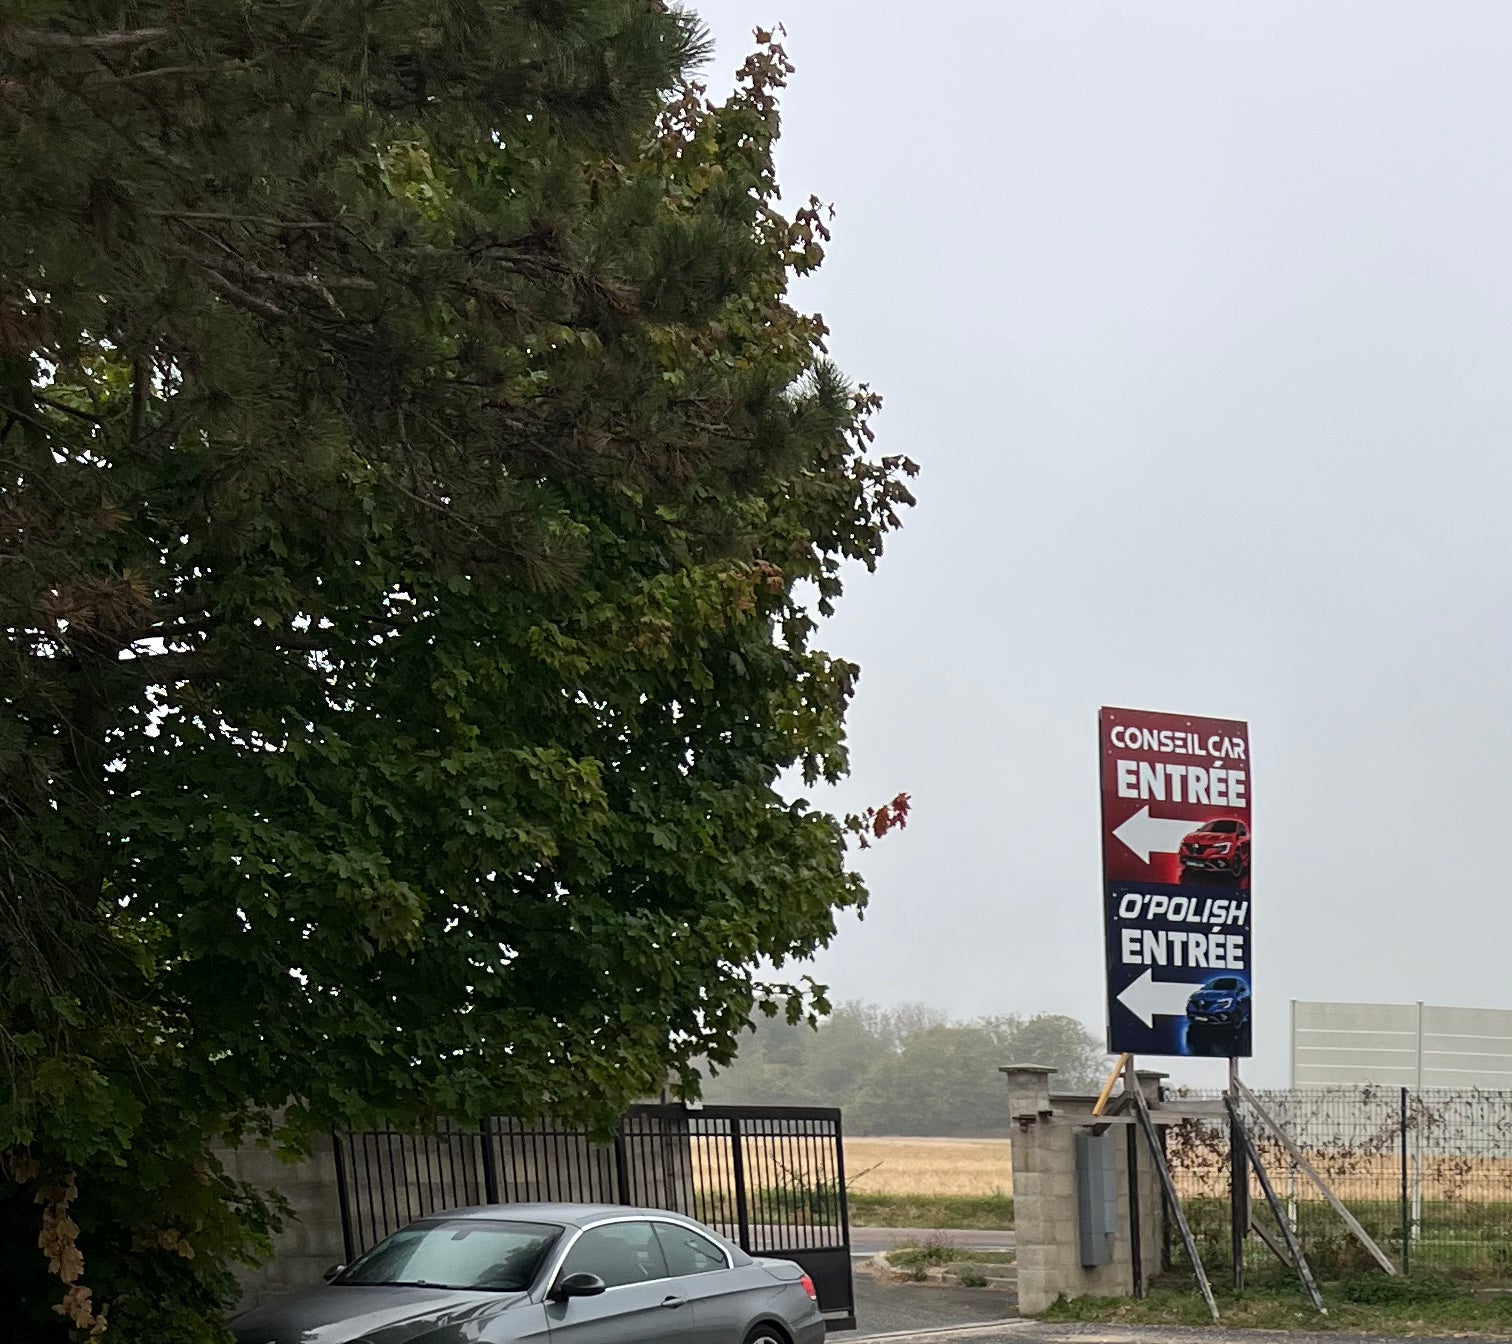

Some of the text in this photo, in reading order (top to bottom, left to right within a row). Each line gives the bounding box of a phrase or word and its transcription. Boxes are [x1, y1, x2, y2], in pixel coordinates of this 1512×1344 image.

[1111, 726, 1247, 760] CONSEIL CAR
[1117, 759, 1247, 808] ENTRÉE
[1118, 893, 1248, 926] O'POLISH
[1121, 927, 1244, 970] ENTRÉE
